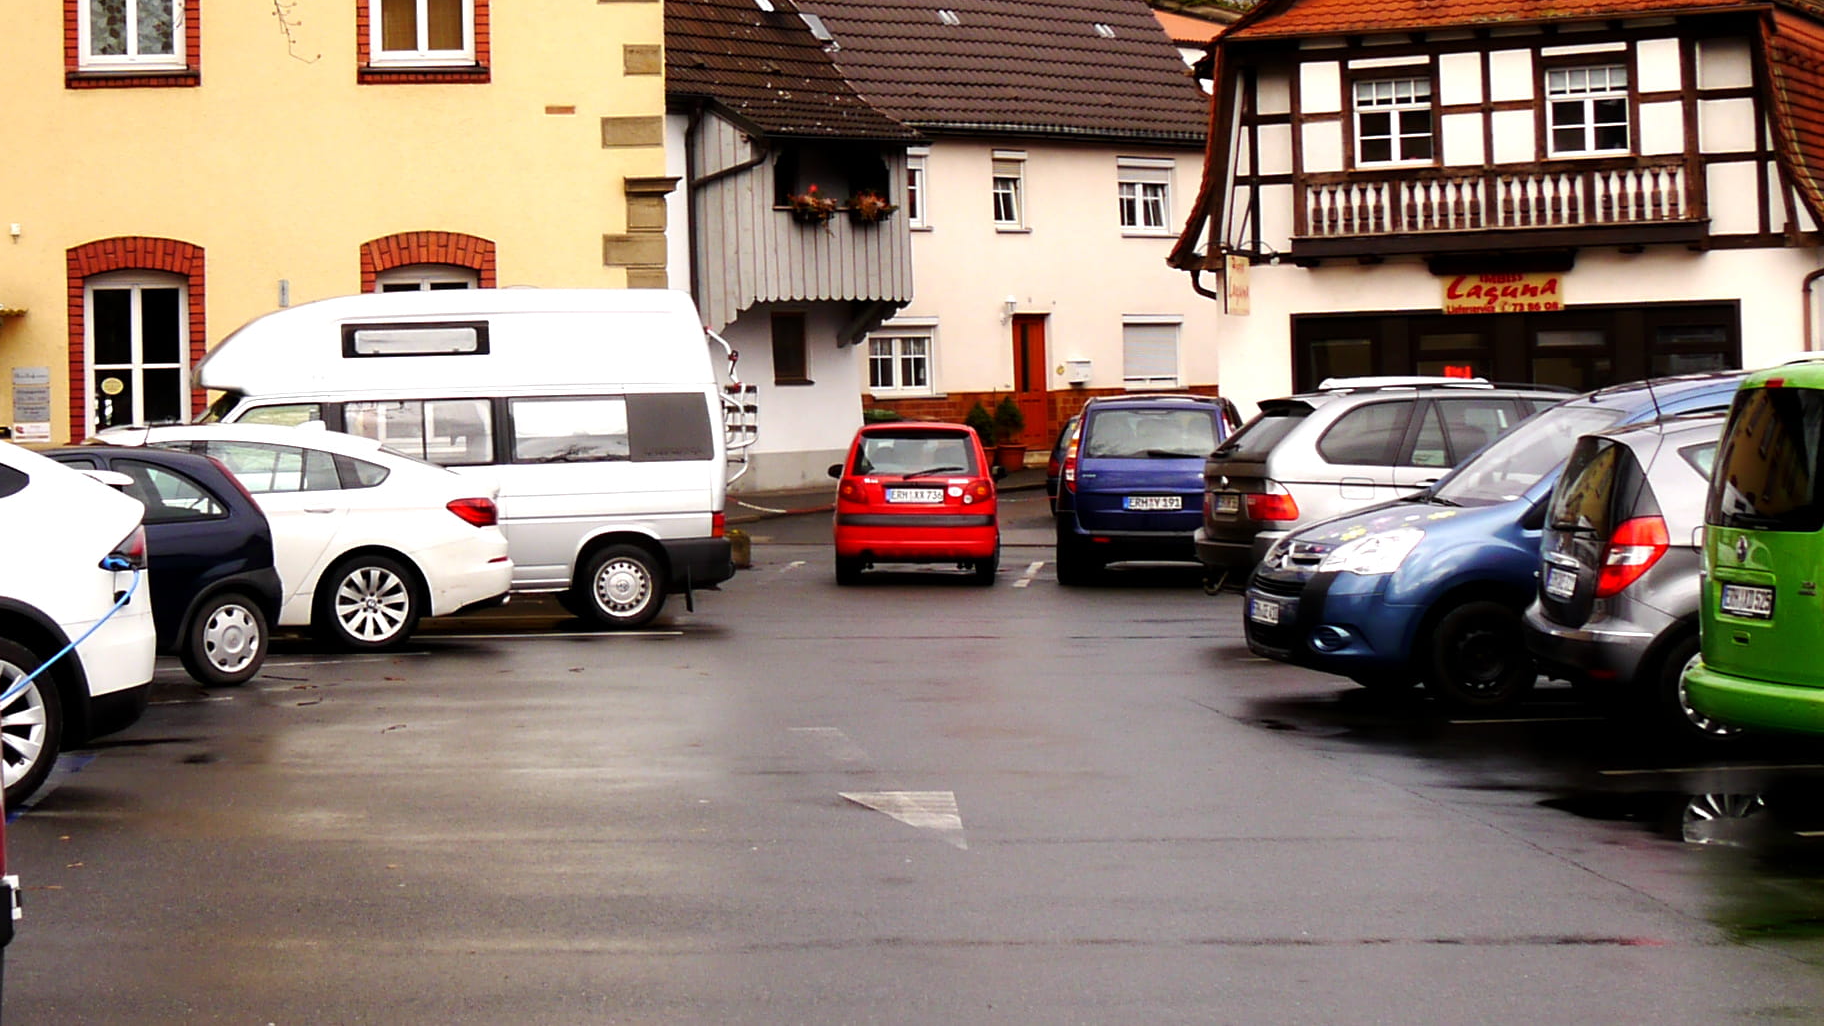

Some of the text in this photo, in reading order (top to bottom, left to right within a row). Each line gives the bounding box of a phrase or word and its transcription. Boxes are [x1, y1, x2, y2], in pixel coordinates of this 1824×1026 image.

[1512, 303, 1525, 312] 73
[927, 490, 943, 500] 736
[1162, 498, 1180, 508] 191
